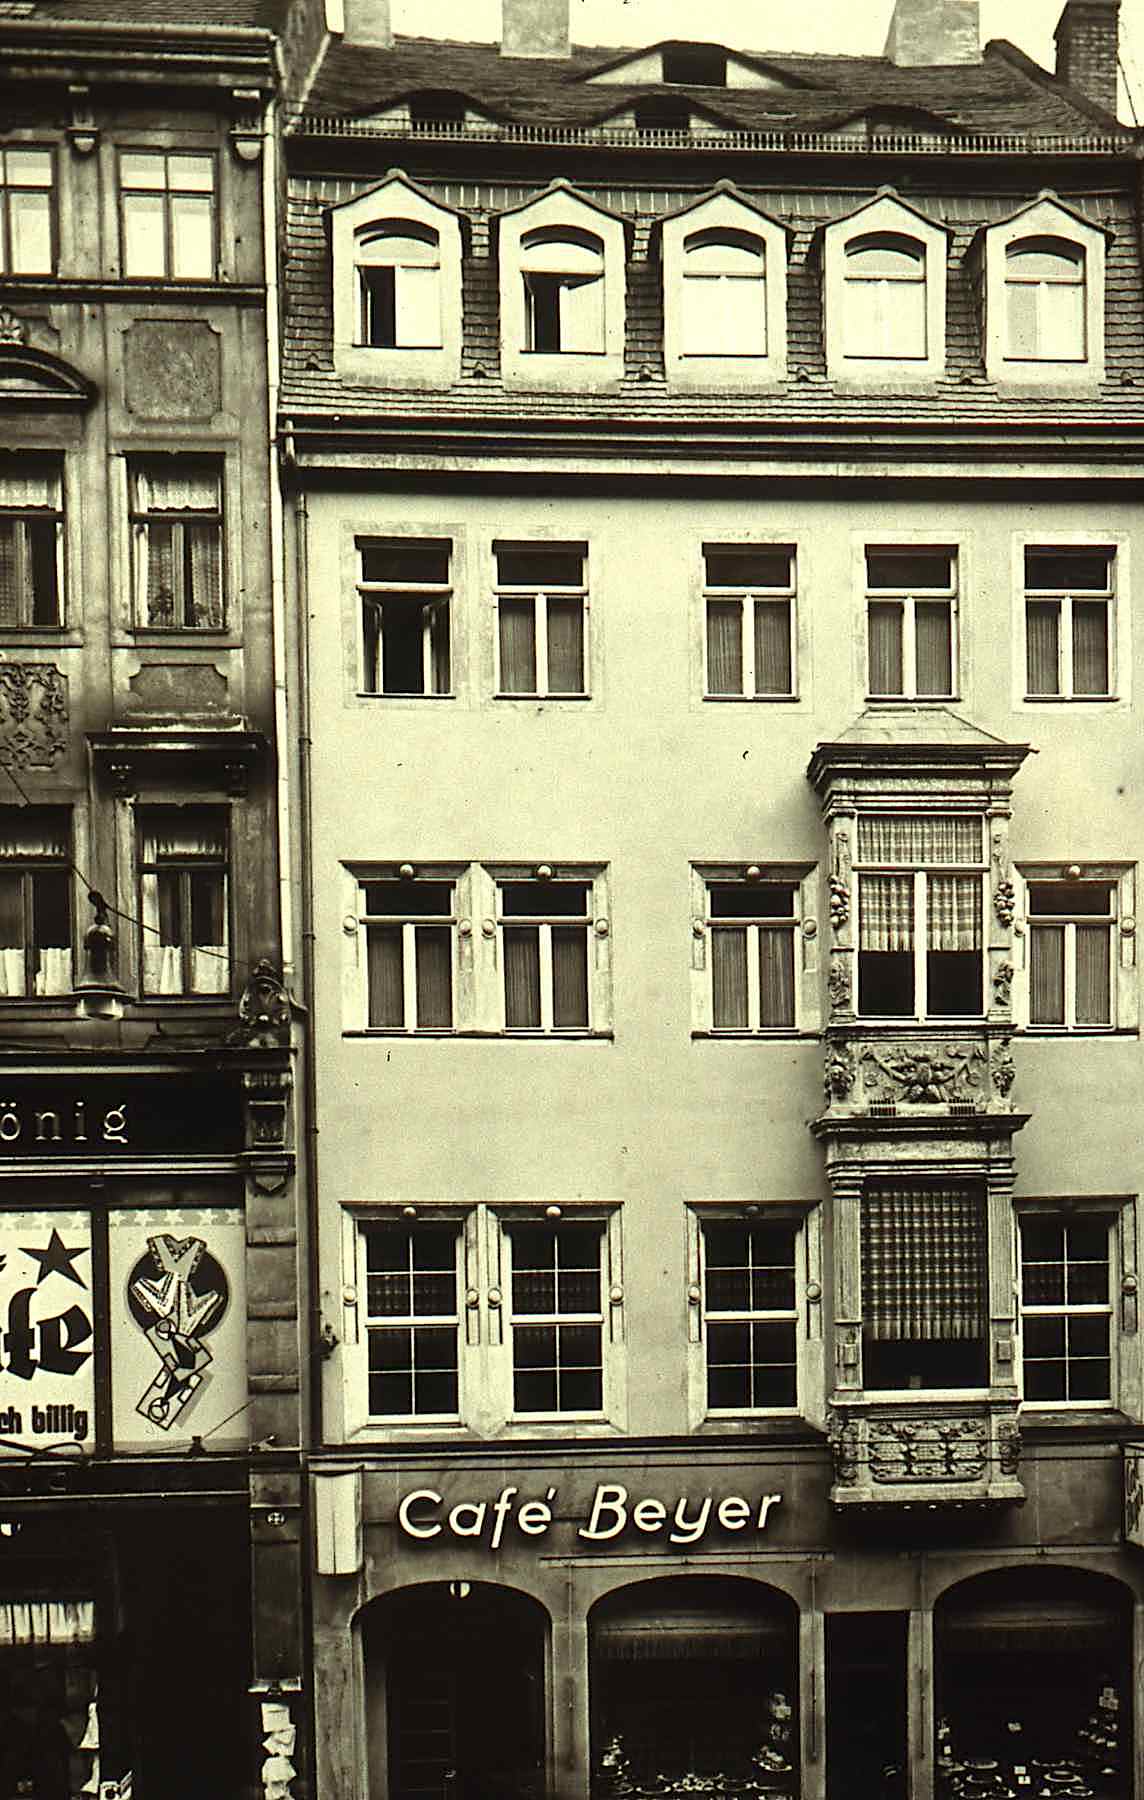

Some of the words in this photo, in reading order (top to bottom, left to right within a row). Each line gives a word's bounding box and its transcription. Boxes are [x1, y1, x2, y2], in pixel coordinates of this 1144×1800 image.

[0, 1102, 128, 1143] önig
[0, 1287, 93, 1380] fe
[31, 1404, 88, 1440] billig
[399, 1487, 556, 1548] Café
[578, 1485, 781, 1543] Beyer
